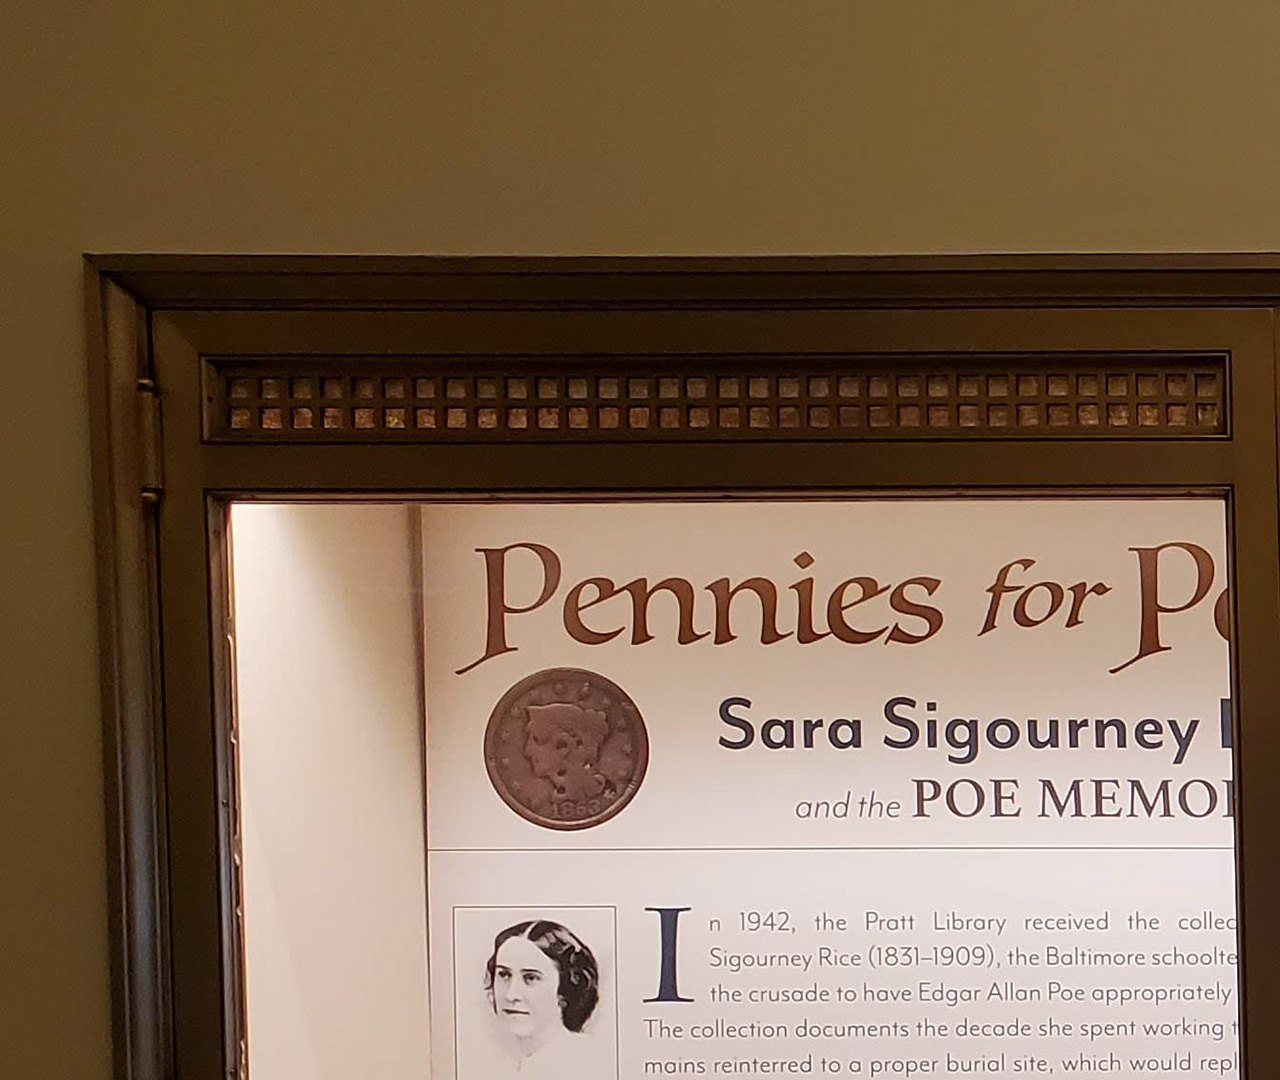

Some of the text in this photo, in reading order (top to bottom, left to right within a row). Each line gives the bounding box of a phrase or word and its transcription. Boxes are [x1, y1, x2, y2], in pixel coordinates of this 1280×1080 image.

[455, 542, 944, 675] Pennies
[977, 558, 1112, 636] for
[718, 697, 862, 750] Sara
[883, 697, 1200, 764] Sigourney
[795, 790, 851, 819] and
[857, 790, 901, 819] the
[911, 777, 1021, 818] POE
[709, 919, 721, 932] n
[739, 911, 796, 935] 1942,
[814, 911, 847, 932] the
[865, 911, 915, 931] Pratt
[933, 910, 1007, 937] Library
[1024, 910, 1109, 931] received
[1127, 910, 1160, 931] the
[643, 906, 694, 1003] I
[709, 947, 813, 973] Sigourney
[818, 946, 862, 967] Rice
[1006, 945, 1040, 967] the
[1046, 945, 1146, 966] Baltimore
